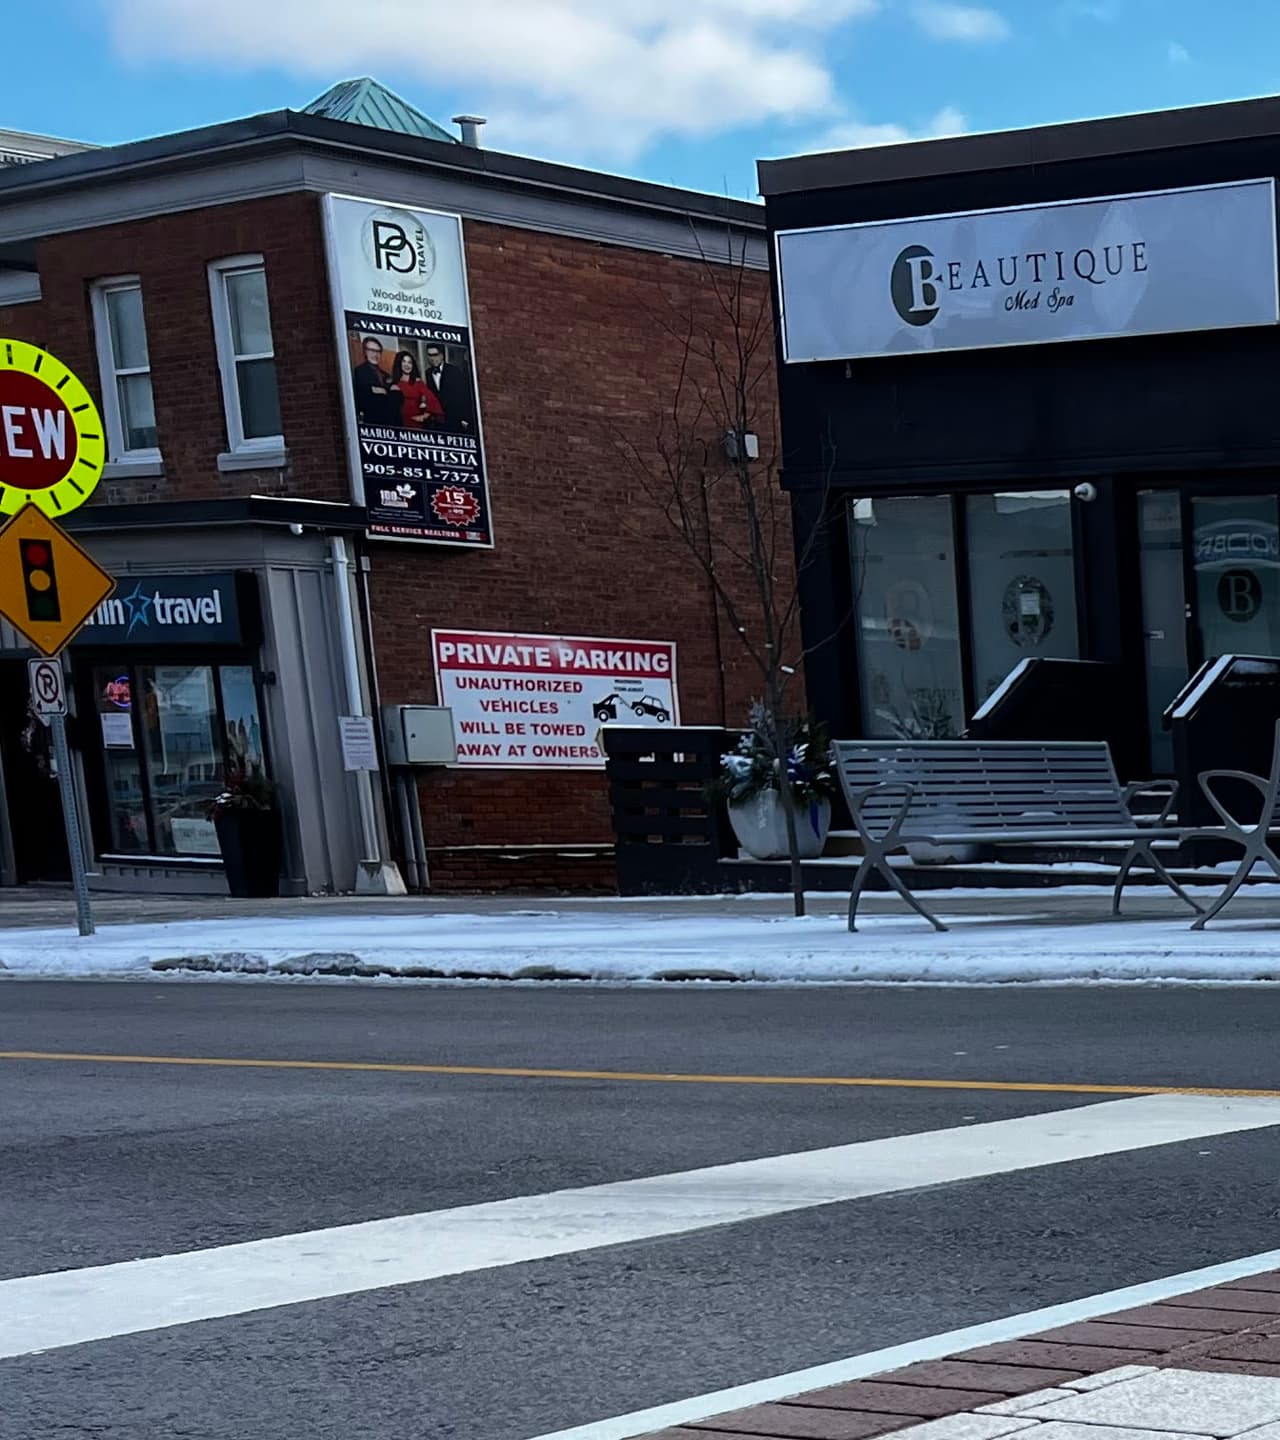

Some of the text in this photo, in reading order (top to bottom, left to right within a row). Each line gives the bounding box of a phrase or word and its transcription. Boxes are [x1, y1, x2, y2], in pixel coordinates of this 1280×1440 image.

[415, 228, 428, 276] TRAVEL
[903, 242, 1148, 315] BEAUTIQUE
[371, 287, 436, 308] Woodbridge
[1004, 286, 1075, 313] Med Spa
[367, 300, 443, 321] (289) 474-1002
[1, 405, 66, 460] EW
[360, 426, 477, 449] MARIO, MIMMA & PETER
[361, 442, 479, 467] VOLPENTESTA
[363, 462, 480, 484] 905-851-7373
[153, 589, 223, 625] travel
[439, 641, 671, 673] PRIVATE PARKING
[455, 676, 584, 694] UNAUTHORIZED
[479, 699, 560, 714] VEHICLES
[460, 721, 586, 737] WILL BE TOWED
[457, 743, 600, 758] AWAY AT OWNERS
